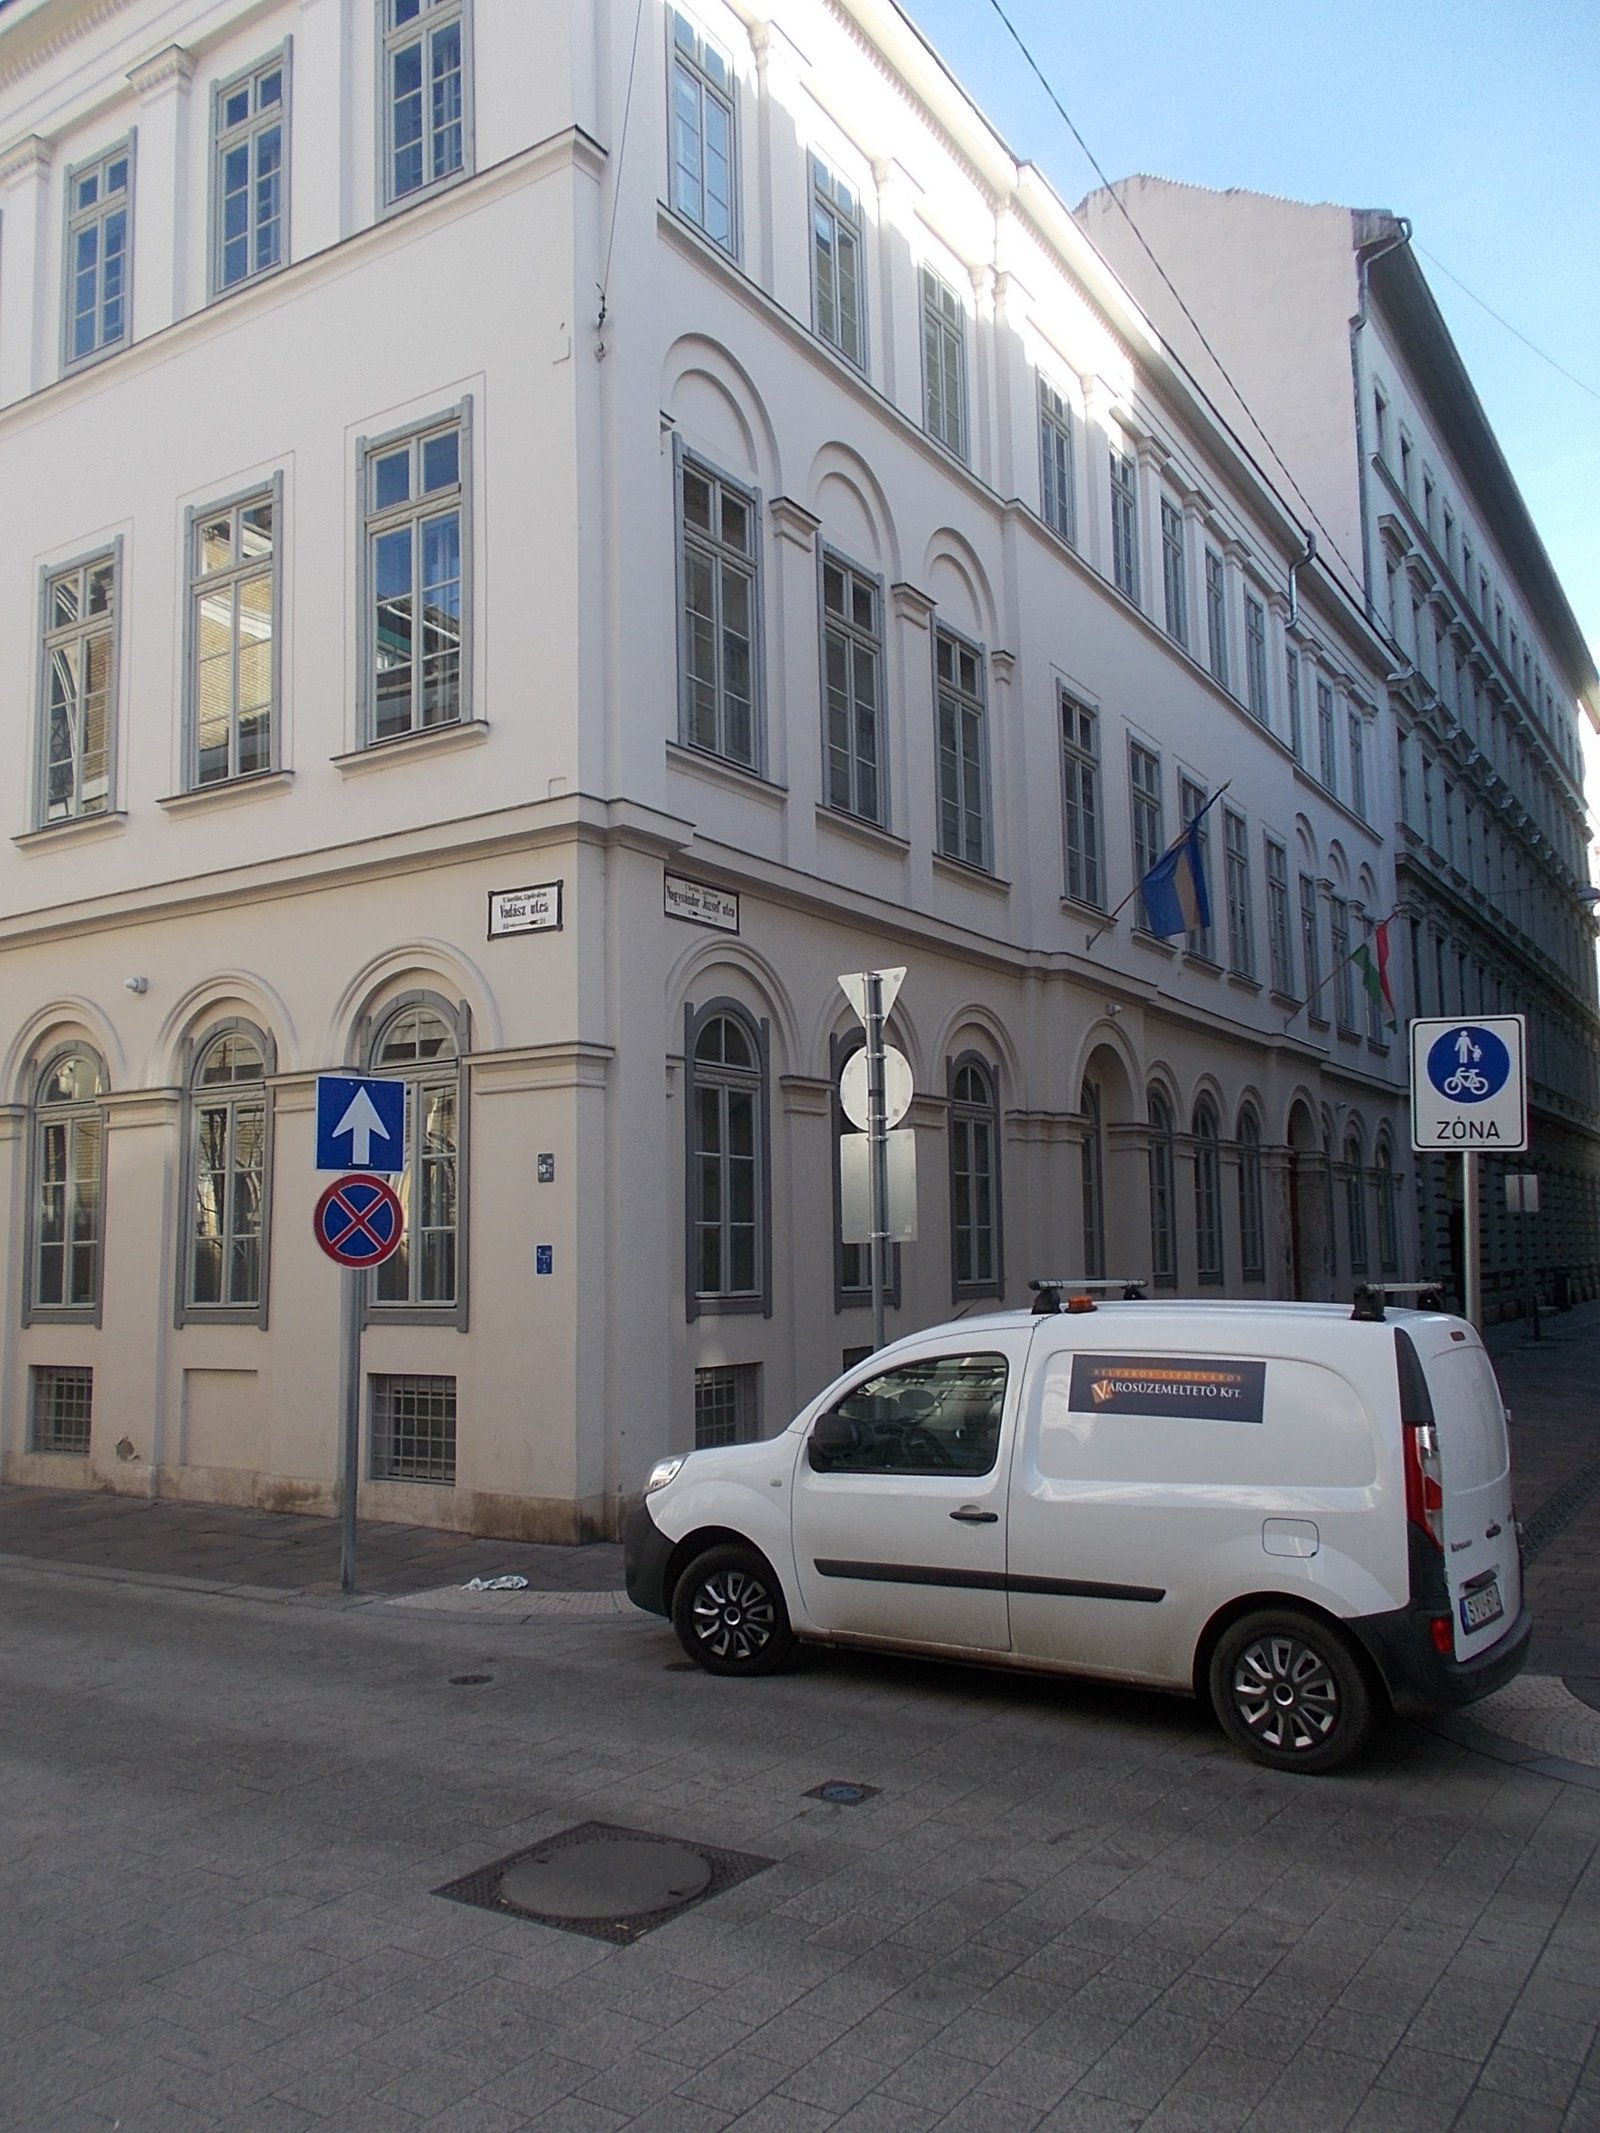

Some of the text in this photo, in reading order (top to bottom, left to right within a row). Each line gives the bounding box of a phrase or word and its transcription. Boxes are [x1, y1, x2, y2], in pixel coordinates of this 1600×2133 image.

[499, 899, 549, 919] Vadász utca
[1436, 1115, 1501, 1140] ZÓNA
